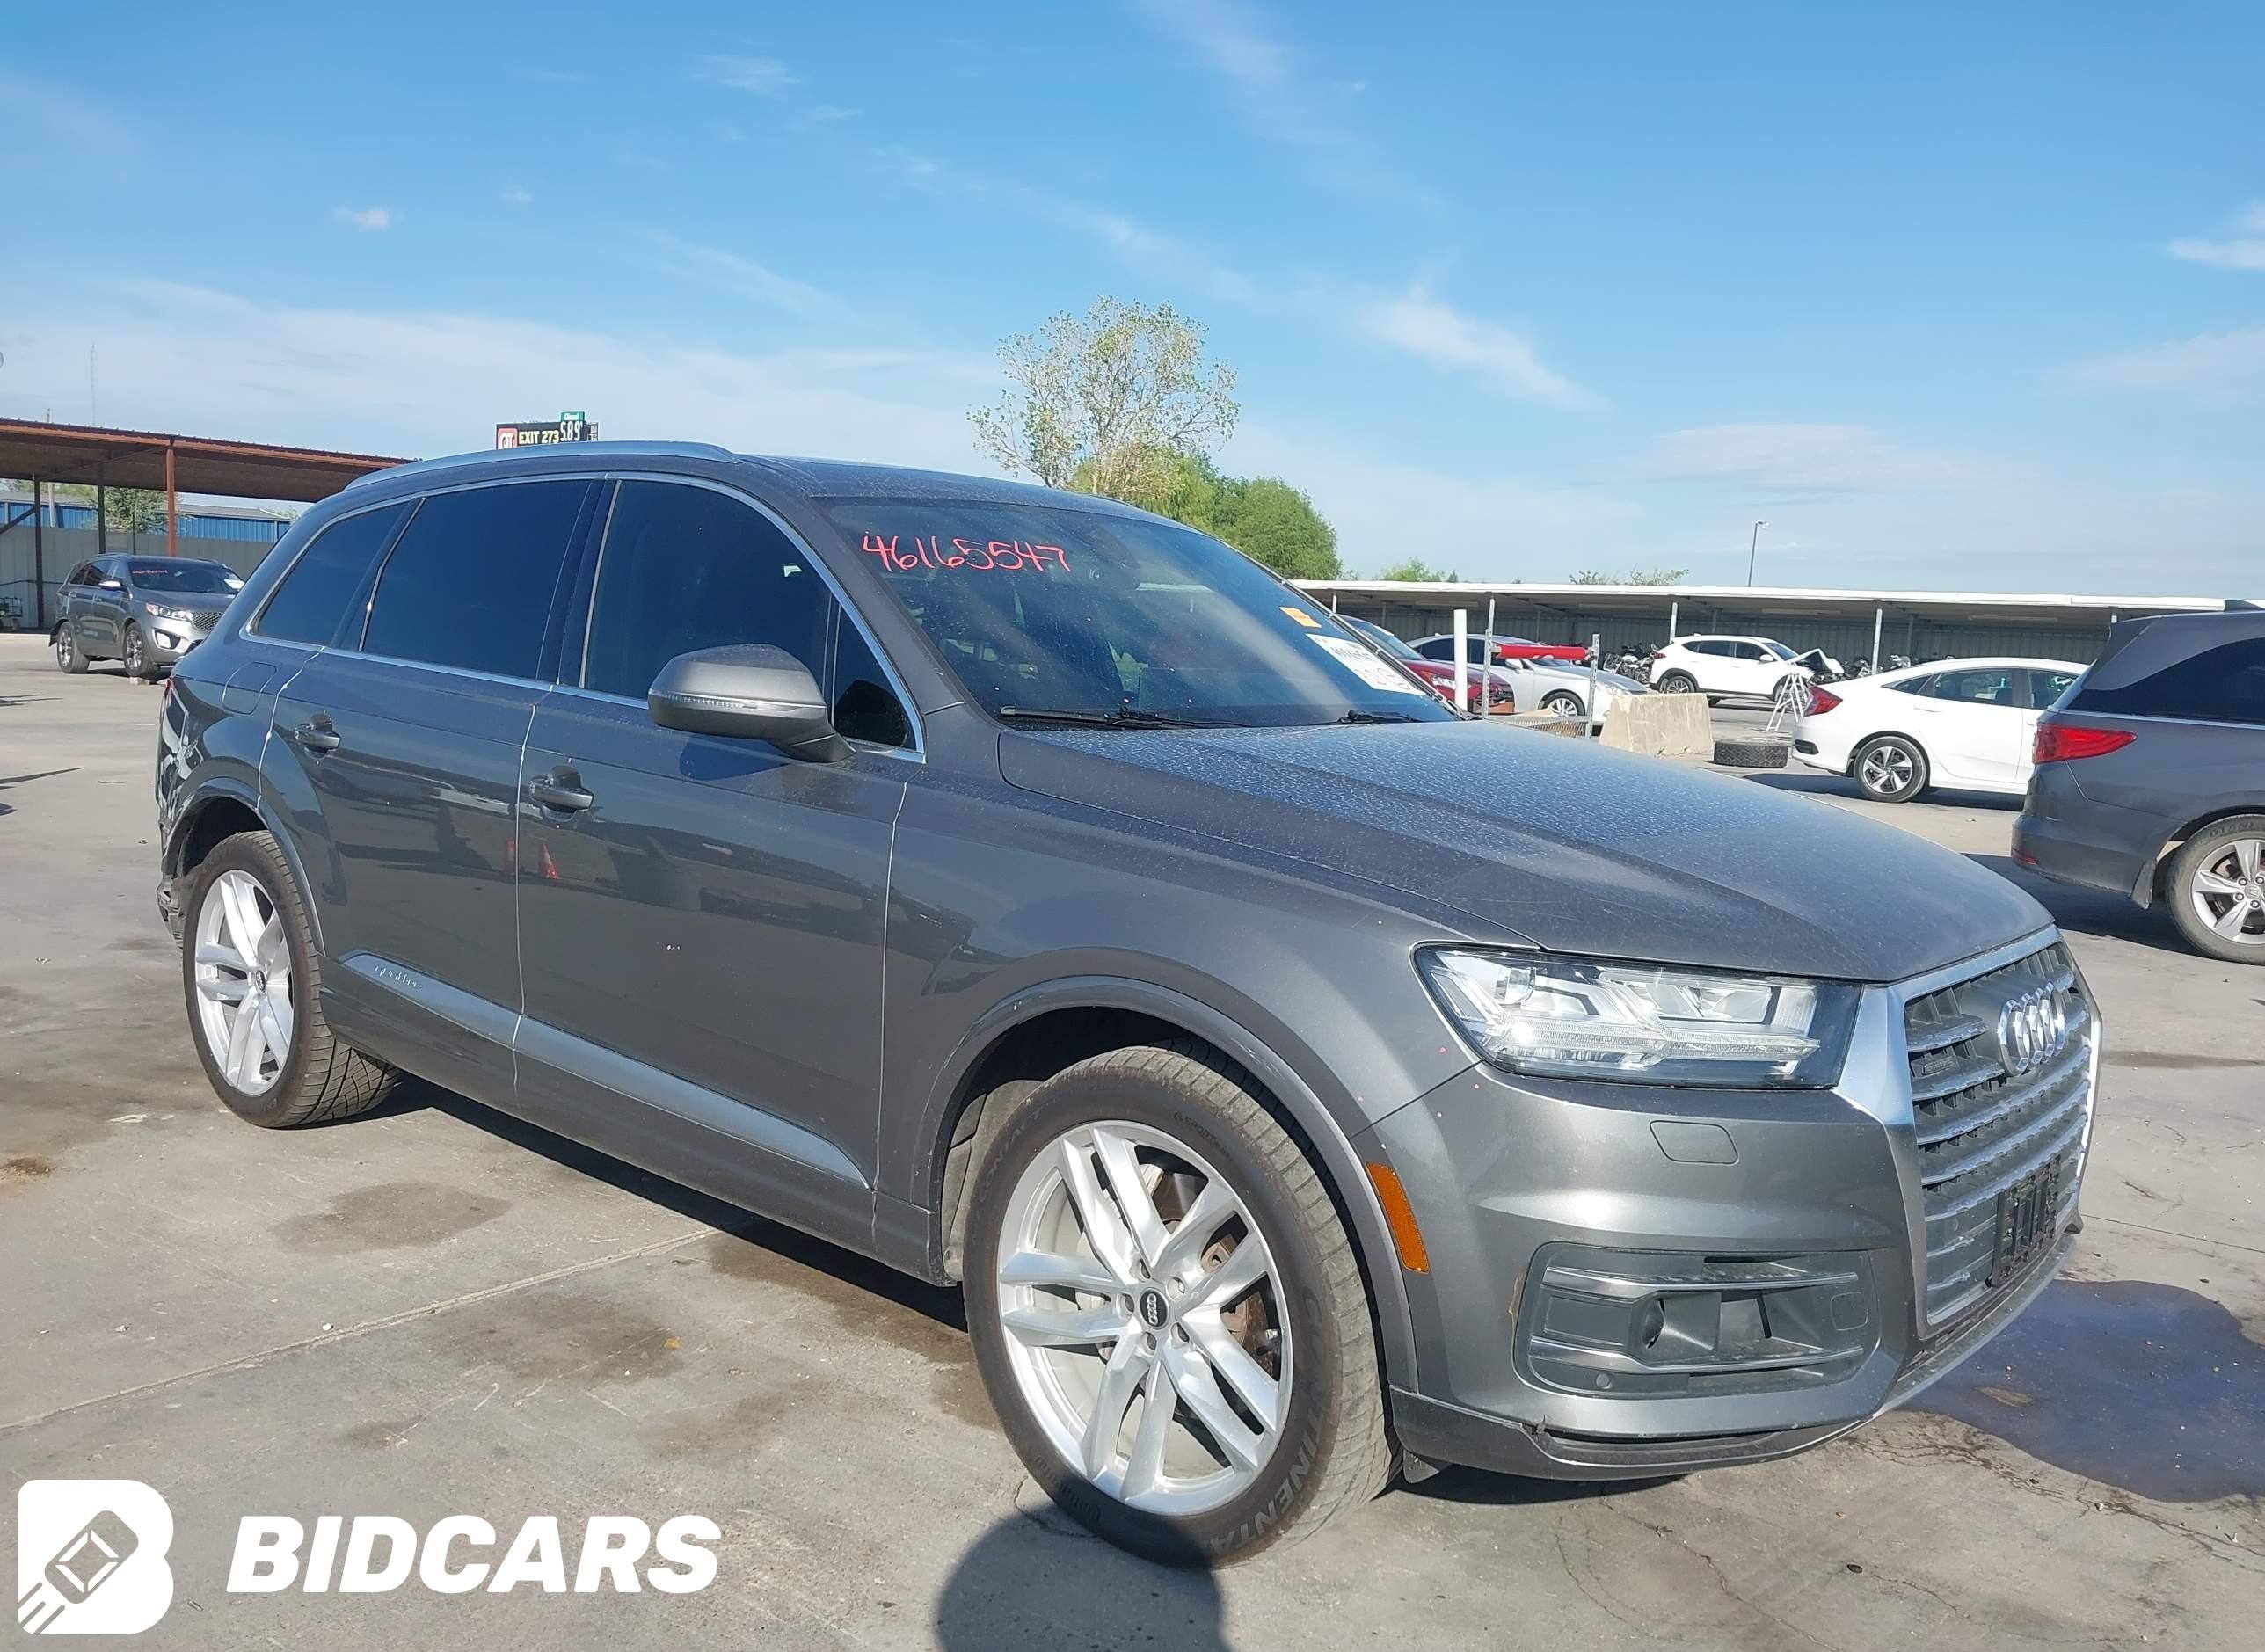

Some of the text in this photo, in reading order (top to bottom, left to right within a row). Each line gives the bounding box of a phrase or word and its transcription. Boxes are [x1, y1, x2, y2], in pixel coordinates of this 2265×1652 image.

[519, 430, 559, 444] EXIT 273
[863, 535, 1071, 572] 46165547
